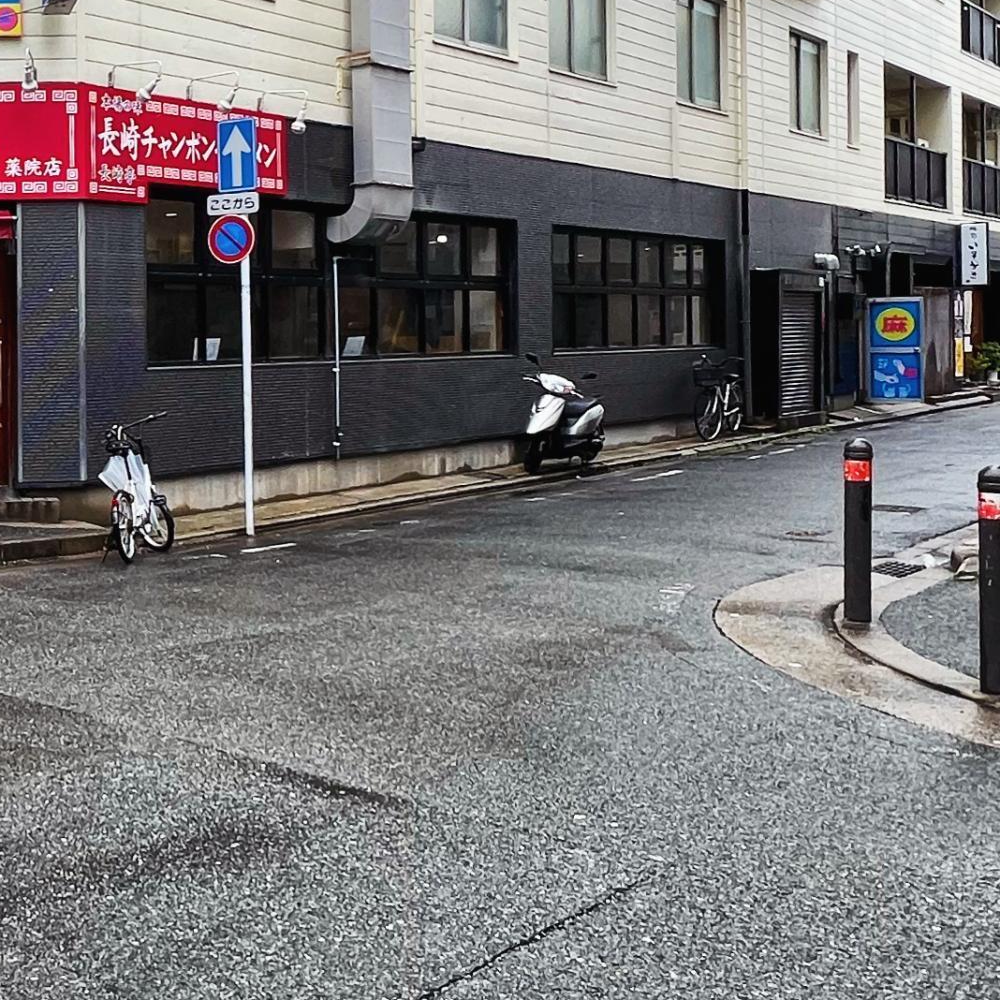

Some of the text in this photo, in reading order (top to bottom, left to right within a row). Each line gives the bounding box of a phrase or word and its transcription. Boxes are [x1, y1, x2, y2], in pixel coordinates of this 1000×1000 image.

[3, 156, 63, 178] 薬院店
[97, 163, 137, 186] 長崎亭
[209, 197, 256, 211] ここから
[881, 314, 908, 334] 麻
